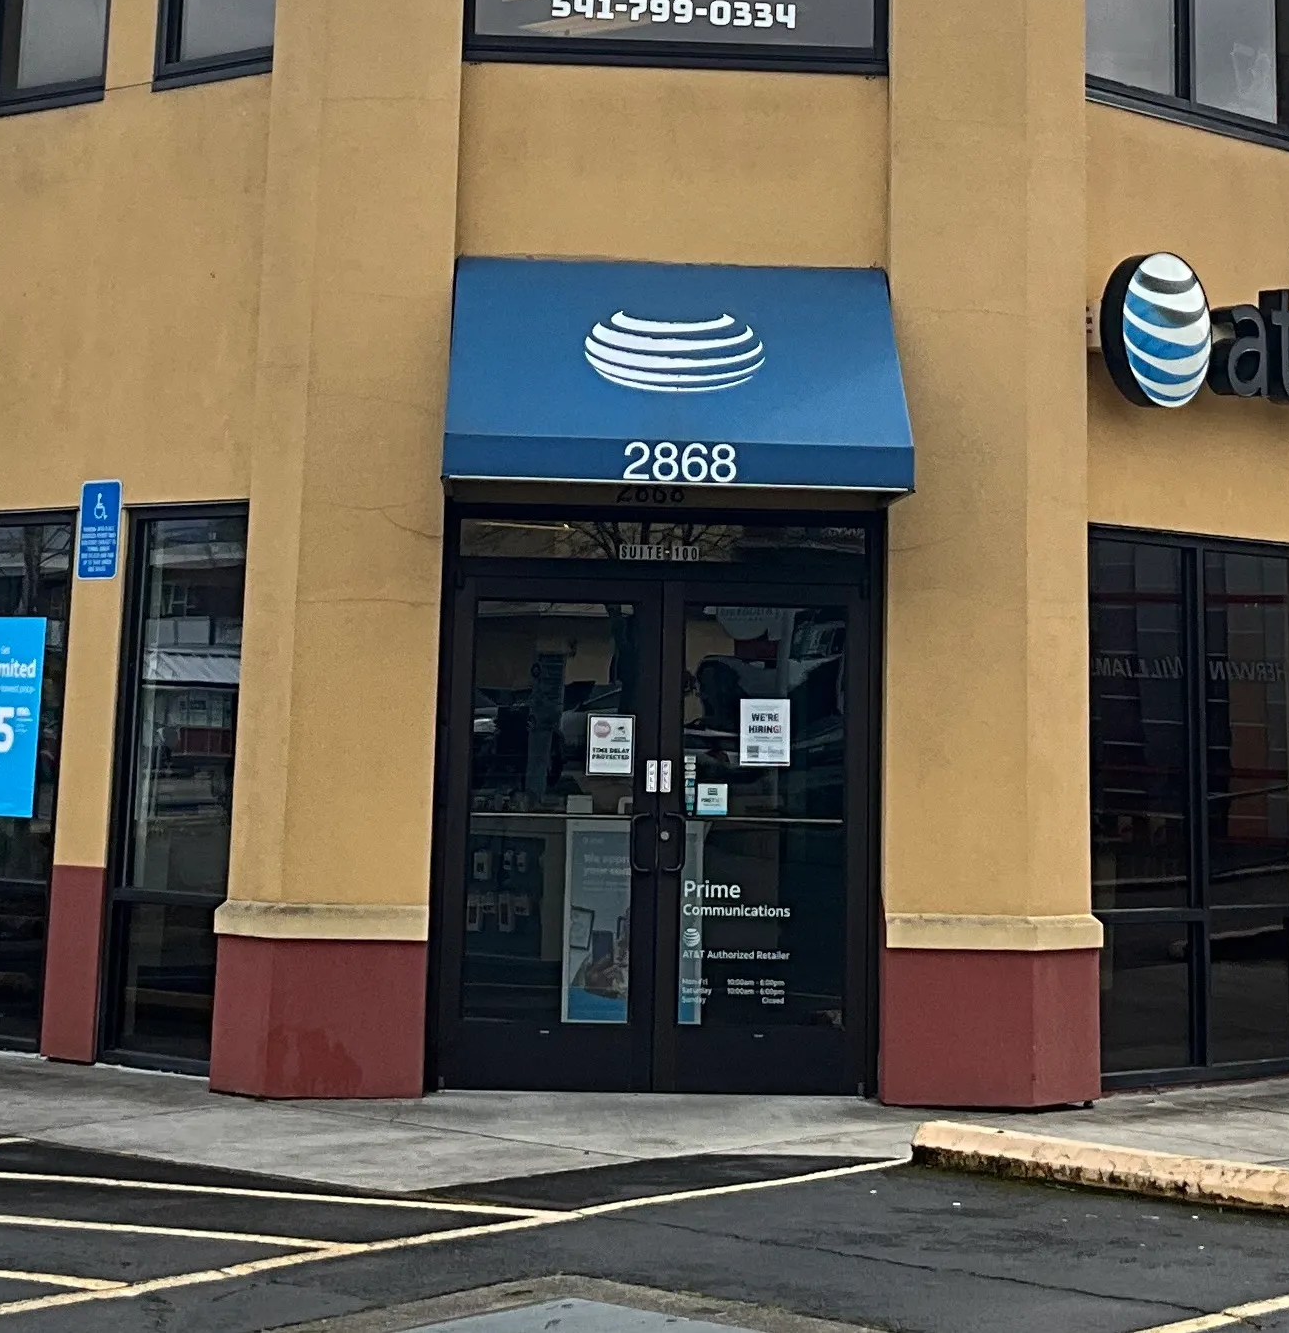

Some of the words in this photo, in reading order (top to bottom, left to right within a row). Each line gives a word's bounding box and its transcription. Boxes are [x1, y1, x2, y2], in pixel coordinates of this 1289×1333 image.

[622, 440, 738, 483] 2868
[751, 712, 780, 722] WE'RE
[683, 879, 741, 899] Prime
[683, 903, 791, 918] Communications
[682, 949, 705, 960] AT&T
[707, 949, 755, 960] Authorized
[756, 950, 791, 960] Retailer
[681, 987, 713, 996] Saturday
[681, 996, 707, 1005] Sunday
[761, 996, 785, 1005] Closed
